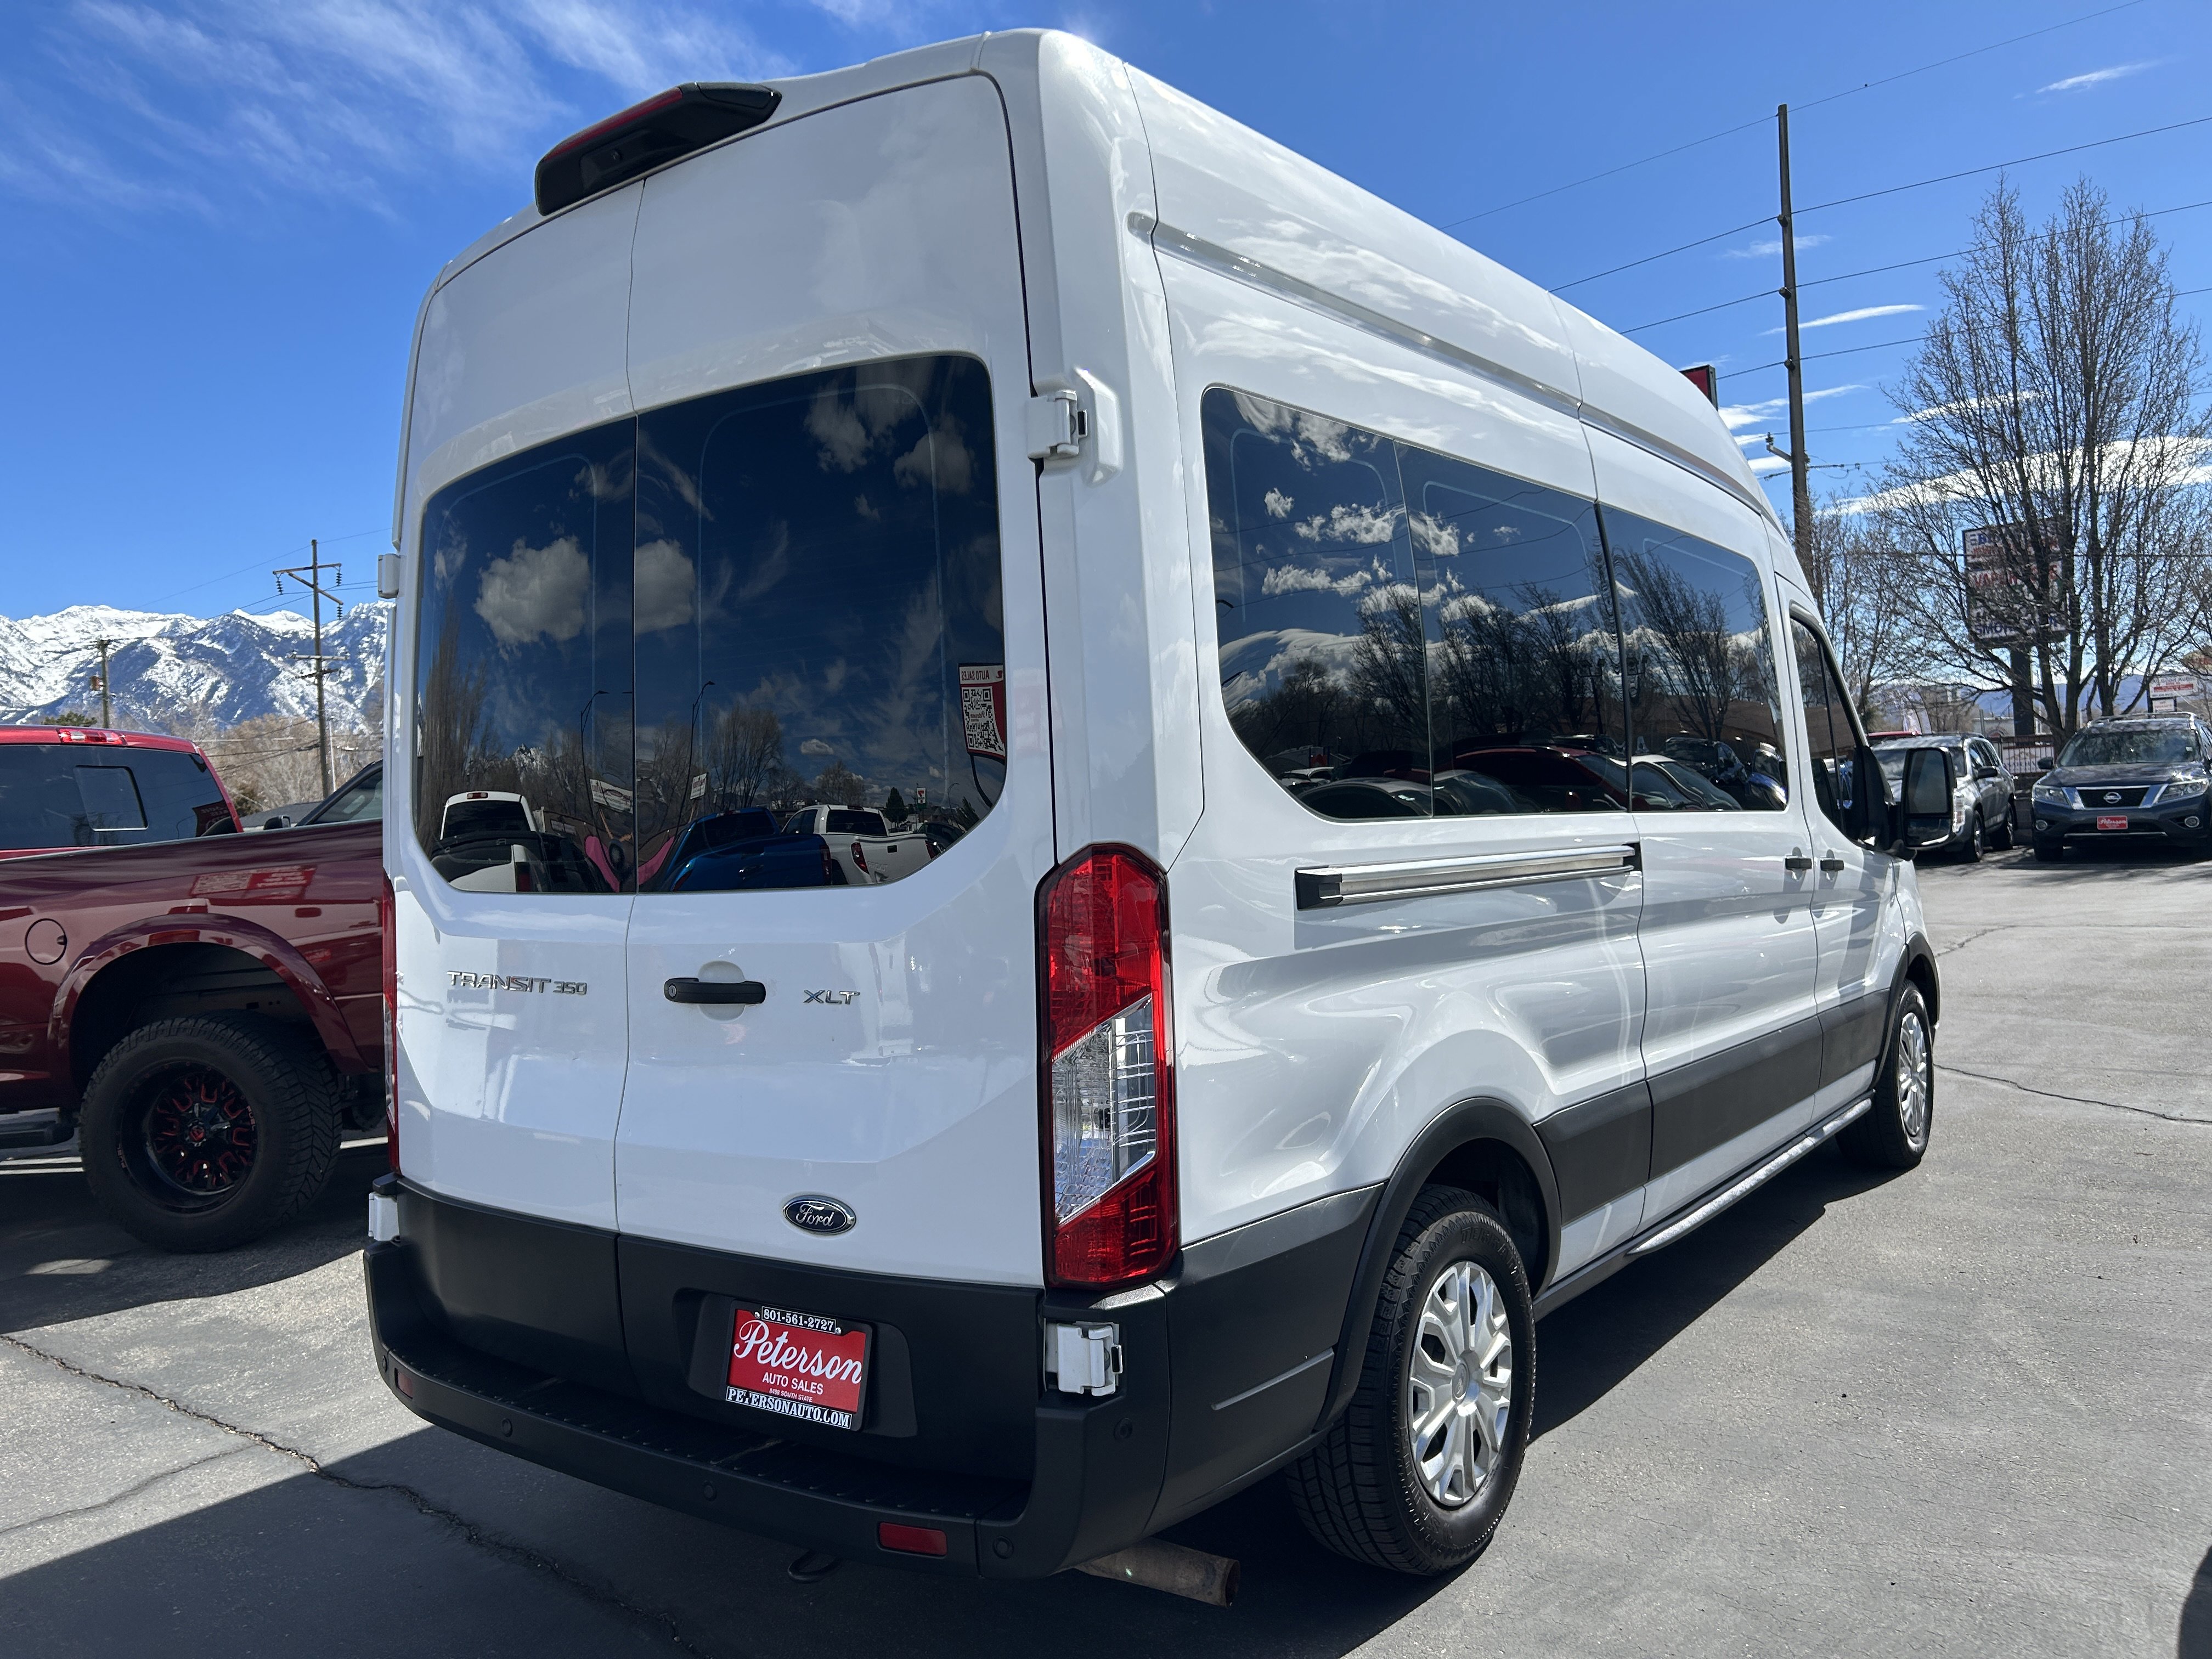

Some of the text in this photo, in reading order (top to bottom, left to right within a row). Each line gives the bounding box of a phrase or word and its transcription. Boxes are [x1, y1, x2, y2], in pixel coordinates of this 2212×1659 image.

[447, 970, 588, 995] TRANSIT 350
[803, 989, 860, 1005] XLT
[246, 1105, 255, 1132] FUEL
[795, 1203, 835, 1227] Ford
[763, 1308, 834, 1331] 801-561-2727
[733, 1319, 862, 1384] Peterson
[762, 1372, 823, 1395] AUTO SALES
[727, 1388, 850, 1427] PETERSONAUTO.COM
[780, 1390, 798, 1400] SOUTH
[798, 1394, 813, 1403] STATE
